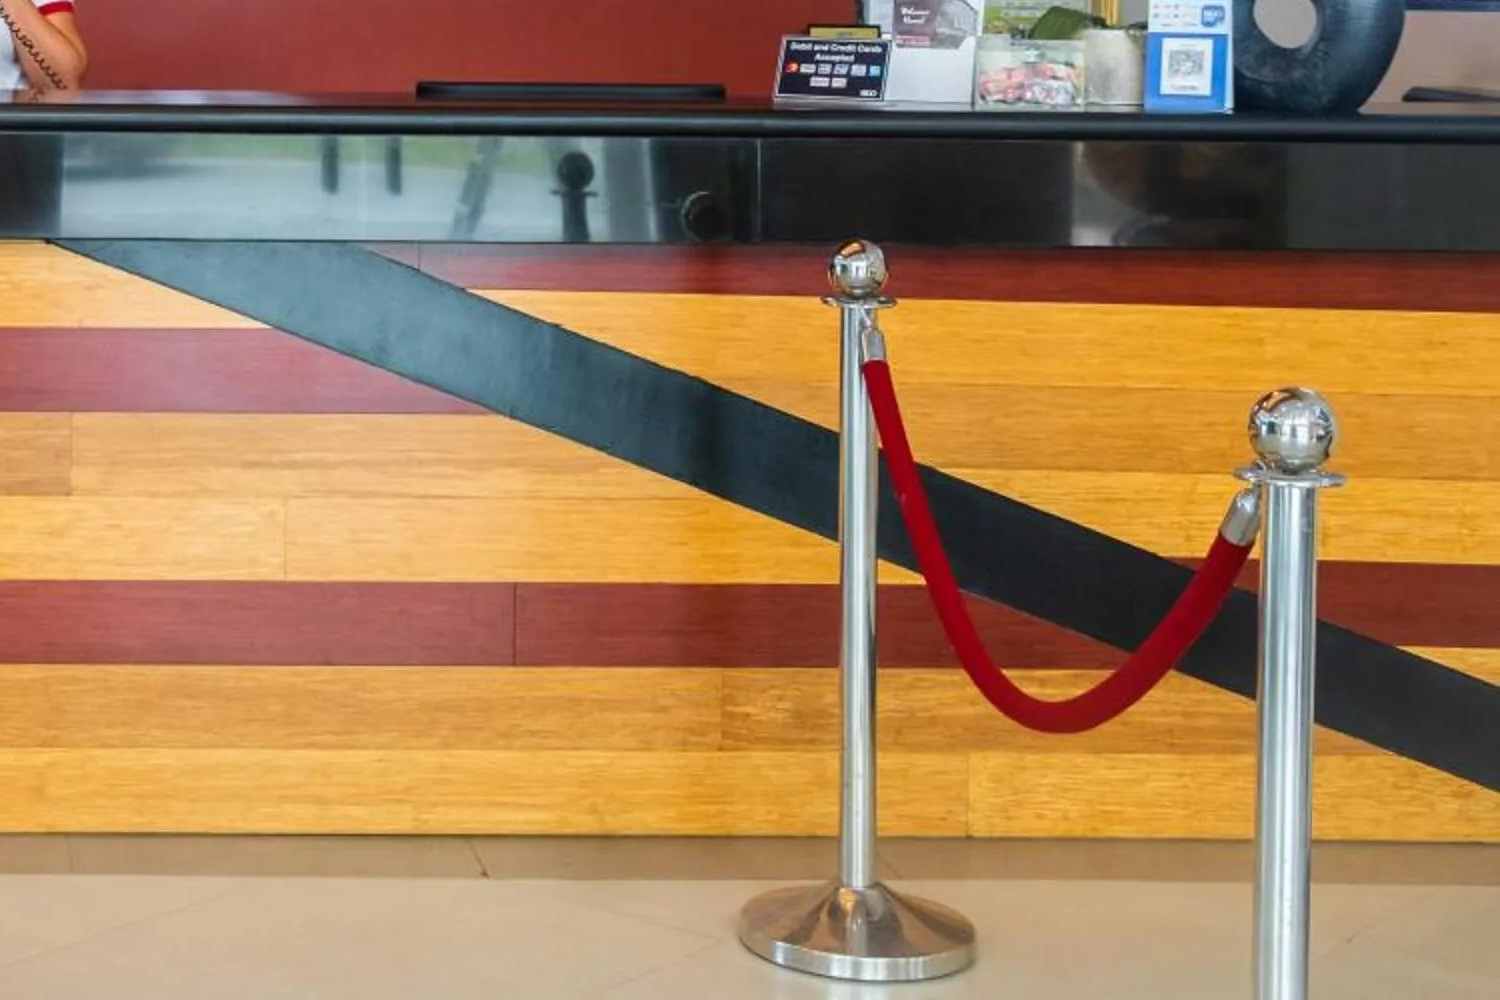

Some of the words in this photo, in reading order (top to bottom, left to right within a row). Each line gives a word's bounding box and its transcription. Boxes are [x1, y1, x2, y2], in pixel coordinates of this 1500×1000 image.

[790, 42, 812, 51] Debit
[813, 43, 829, 51] and
[831, 43, 856, 52] Credit
[857, 45, 883, 53] Cards
[815, 53, 855, 62] Accepted
